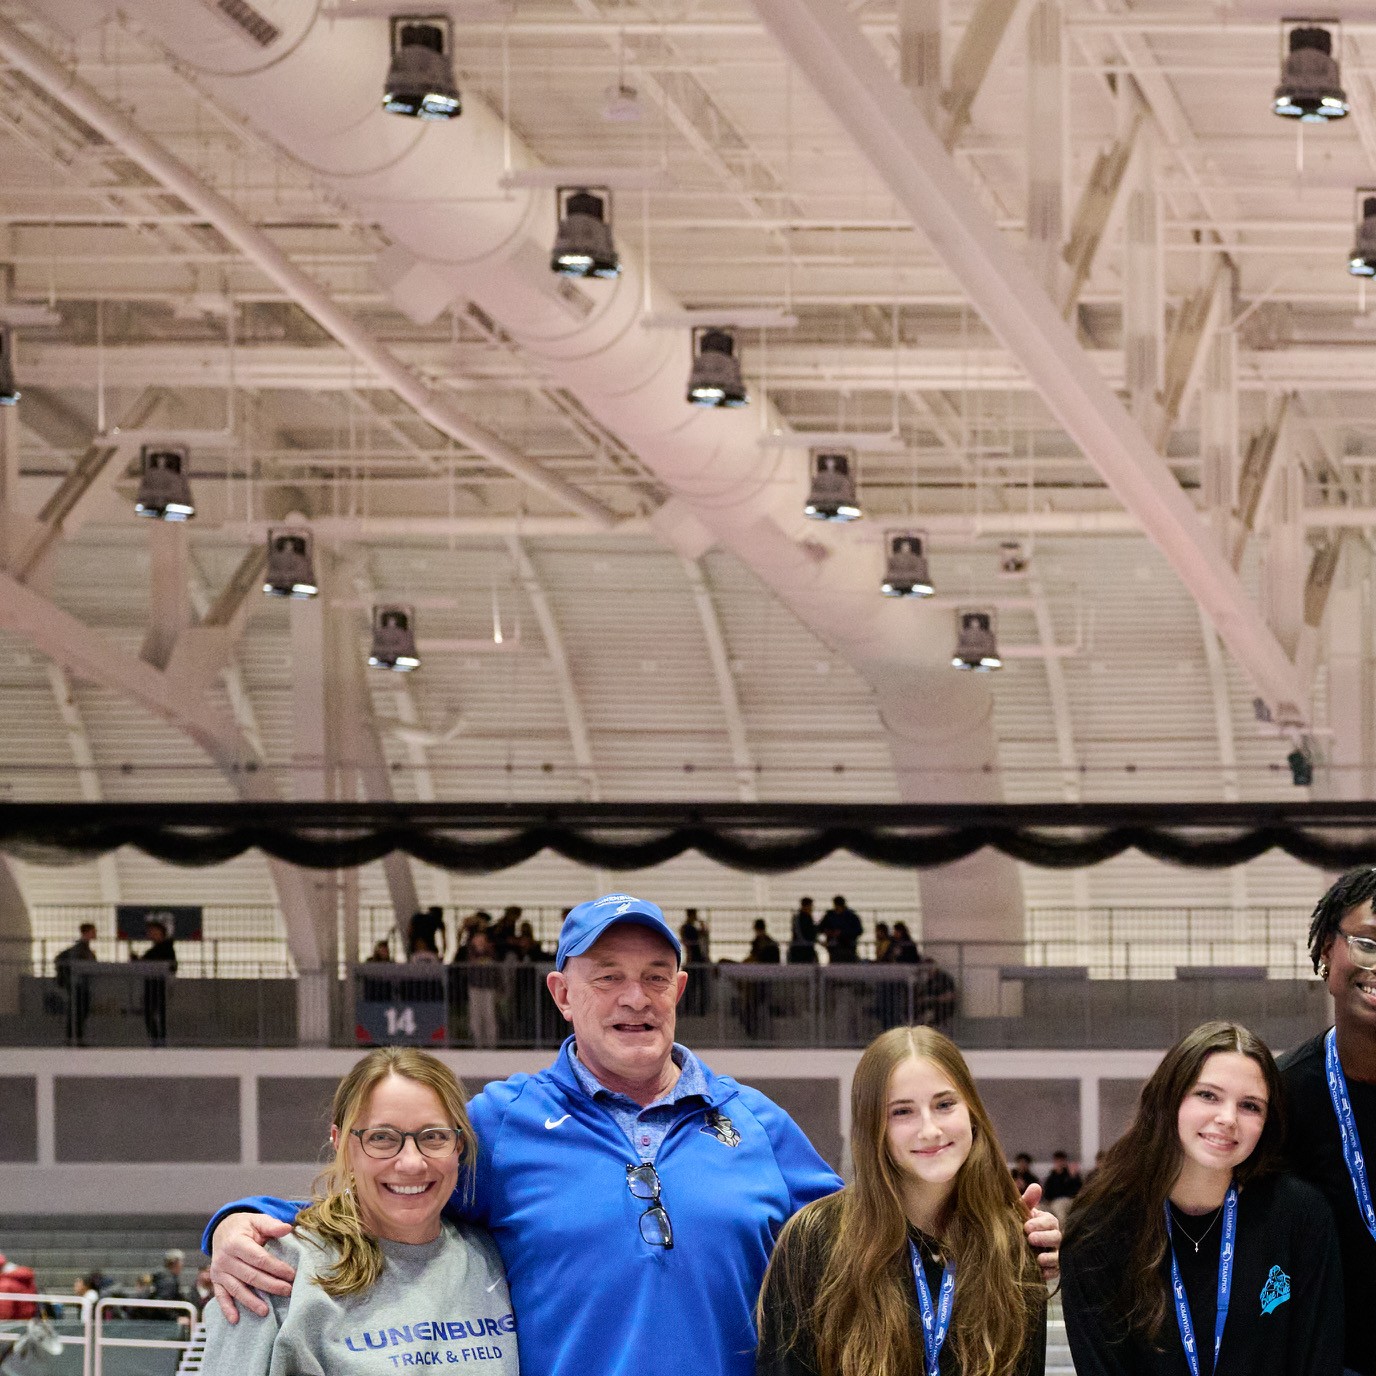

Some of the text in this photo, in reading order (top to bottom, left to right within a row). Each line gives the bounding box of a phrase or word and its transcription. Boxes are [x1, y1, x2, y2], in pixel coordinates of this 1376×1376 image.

[385, 1007, 416, 1036] 14
[344, 1313, 517, 1352] LUNENBURG
[389, 1346, 503, 1368] TRACK & FIELD
